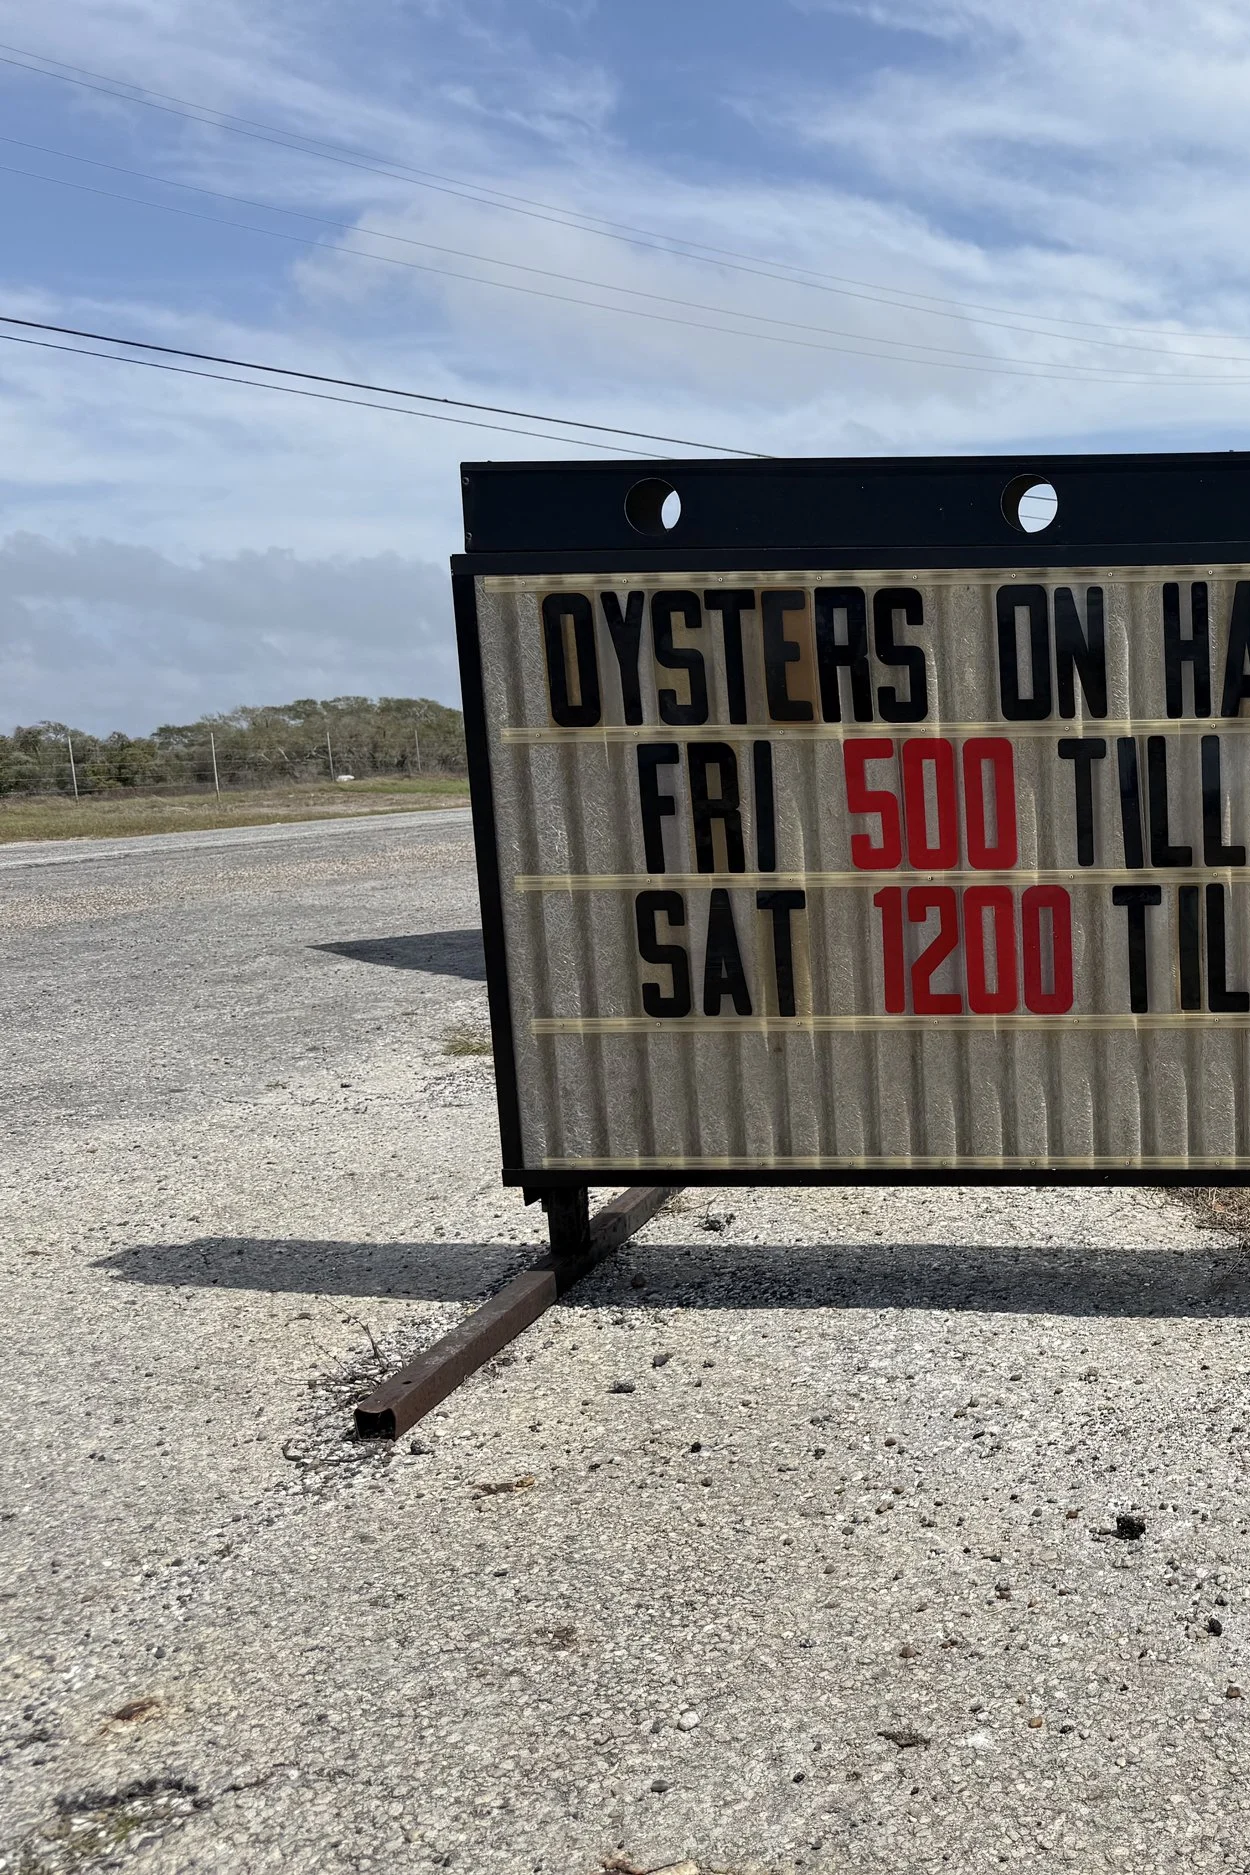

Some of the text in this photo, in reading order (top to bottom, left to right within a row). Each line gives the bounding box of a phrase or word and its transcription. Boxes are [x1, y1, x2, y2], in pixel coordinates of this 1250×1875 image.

[542, 587, 928, 727] OYSTERS
[996, 584, 1107, 720] ON
[636, 740, 776, 874] FRI
[843, 737, 1018, 870] 500
[1058, 735, 1246, 869] TILL
[635, 888, 805, 1018] SAT
[873, 885, 1074, 1015] 1200
